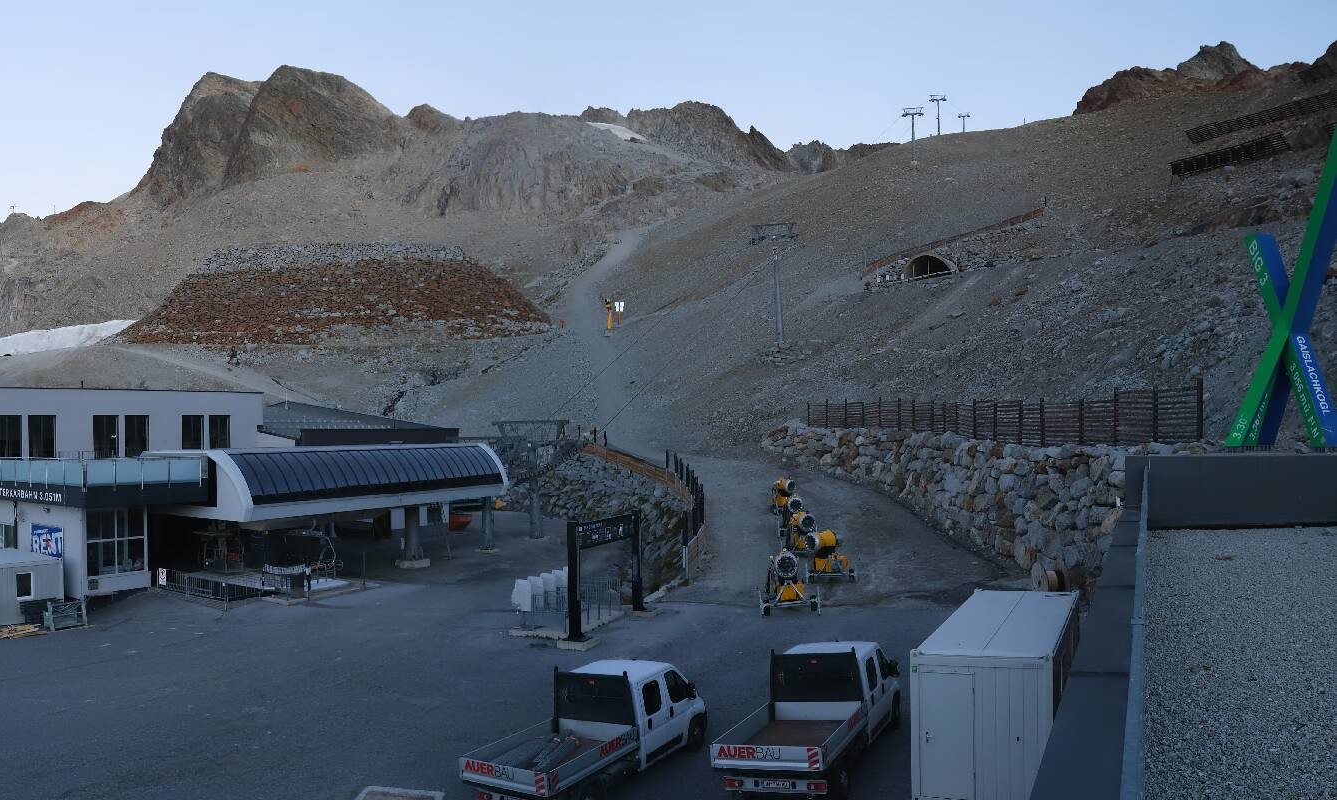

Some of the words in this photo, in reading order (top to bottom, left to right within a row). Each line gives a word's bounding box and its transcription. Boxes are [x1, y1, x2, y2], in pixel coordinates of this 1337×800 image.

[1249, 240, 1264, 272] BIG
[1259, 273, 1269, 286] 3
[1297, 336, 1331, 416] GAISLACHKOGL
[718, 745, 781, 760] AUERBAU
[464, 760, 515, 781] AUERBAU
